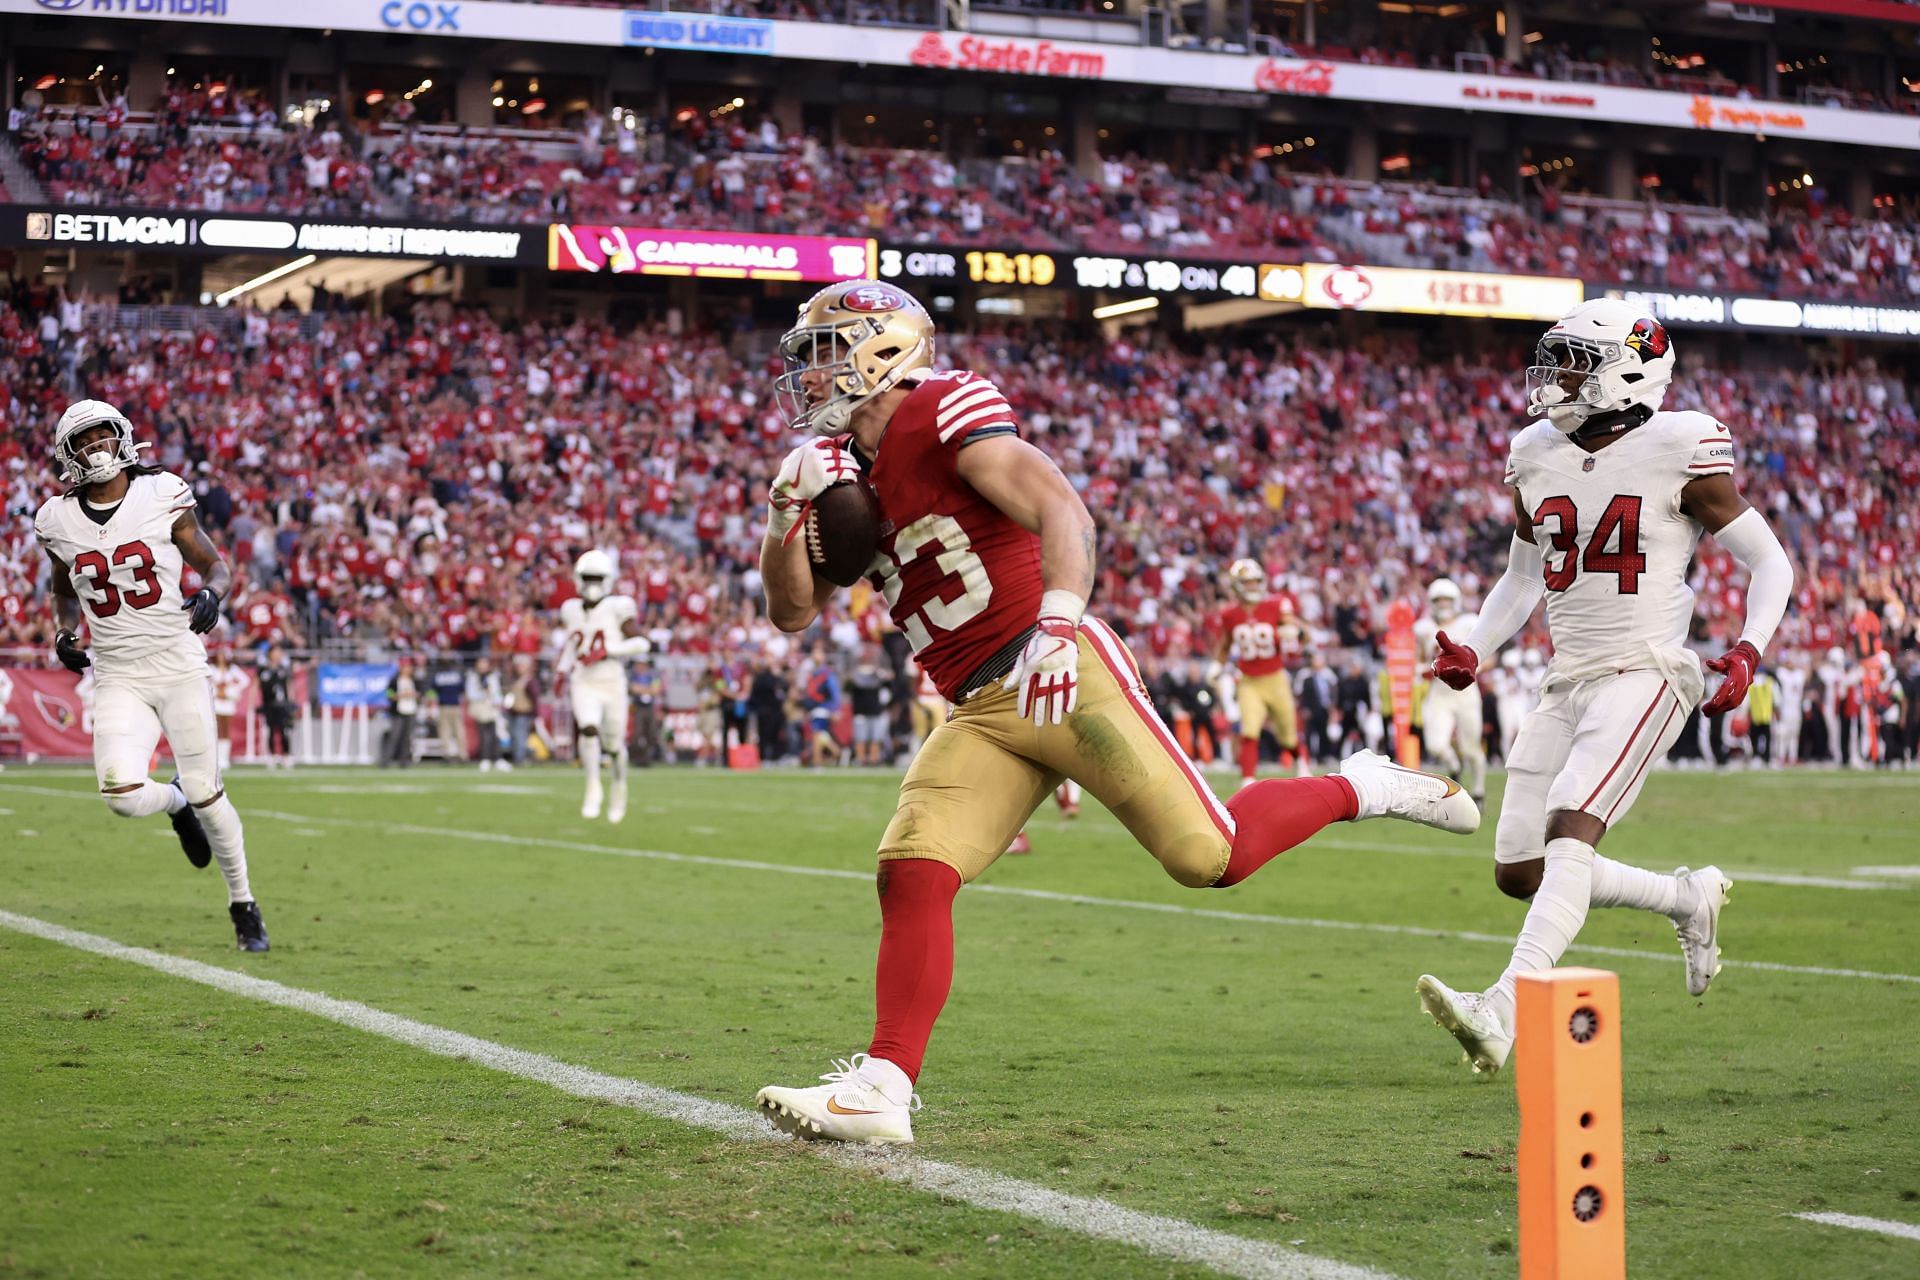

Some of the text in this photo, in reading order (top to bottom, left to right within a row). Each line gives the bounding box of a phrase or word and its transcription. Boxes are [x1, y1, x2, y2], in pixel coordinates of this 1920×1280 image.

[381, 1, 459, 30] COX
[630, 19, 767, 47] BUD LIGHT
[957, 35, 1105, 79] State Farm
[54, 214, 186, 245] BETMGM
[636, 240, 798, 269] CARDINALS
[879, 250, 956, 277] 3 QTR
[965, 251, 1056, 286] 13:19
[1073, 257, 1128, 288] 1ST
[1181, 266, 1218, 290] ON
[1532, 494, 1647, 595] 34
[75, 540, 162, 618] 33
[862, 513, 994, 654] 23
